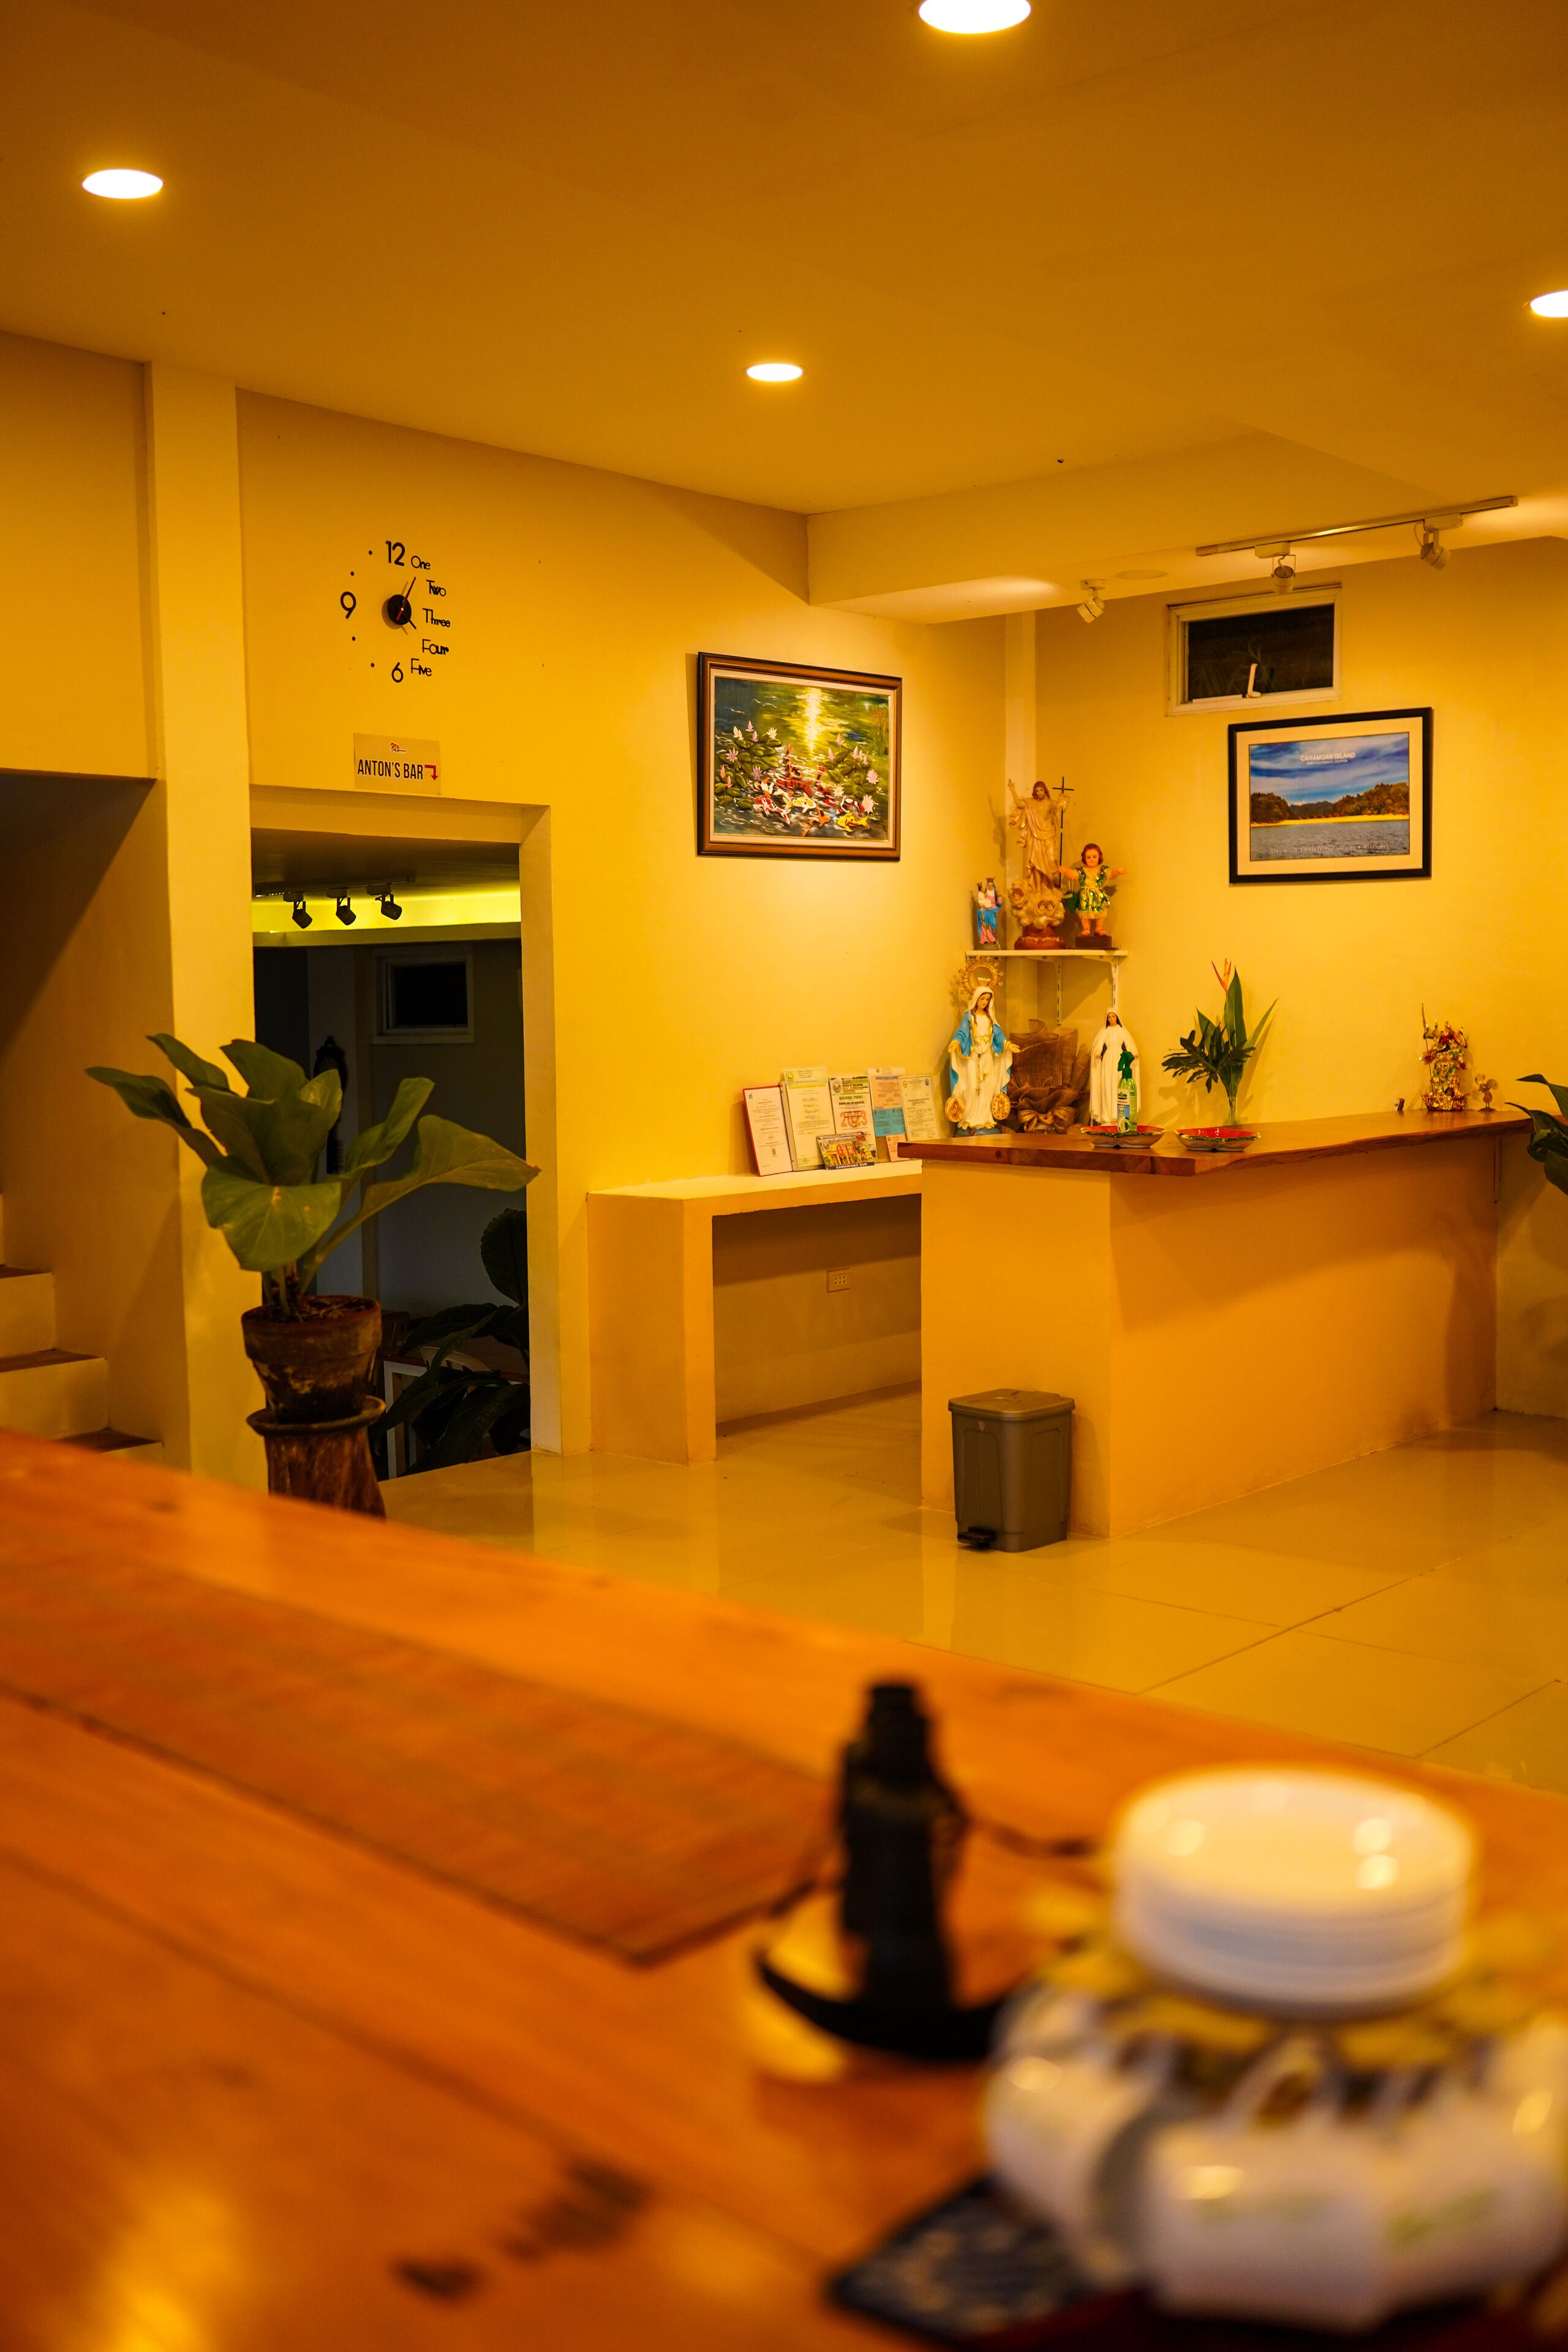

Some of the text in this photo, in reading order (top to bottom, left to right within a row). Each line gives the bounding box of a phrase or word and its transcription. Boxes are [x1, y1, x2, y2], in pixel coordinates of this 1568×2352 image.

[385, 540, 405, 567] 12
[410, 555, 431, 570] One
[426, 579, 447, 597] Two
[340, 590, 357, 620] 9
[422, 608, 451, 628] Three
[421, 638, 450, 655] Four
[391, 662, 404, 683] 6
[410, 658, 432, 677] Five
[357, 758, 424, 780] ANTON'S BAR
